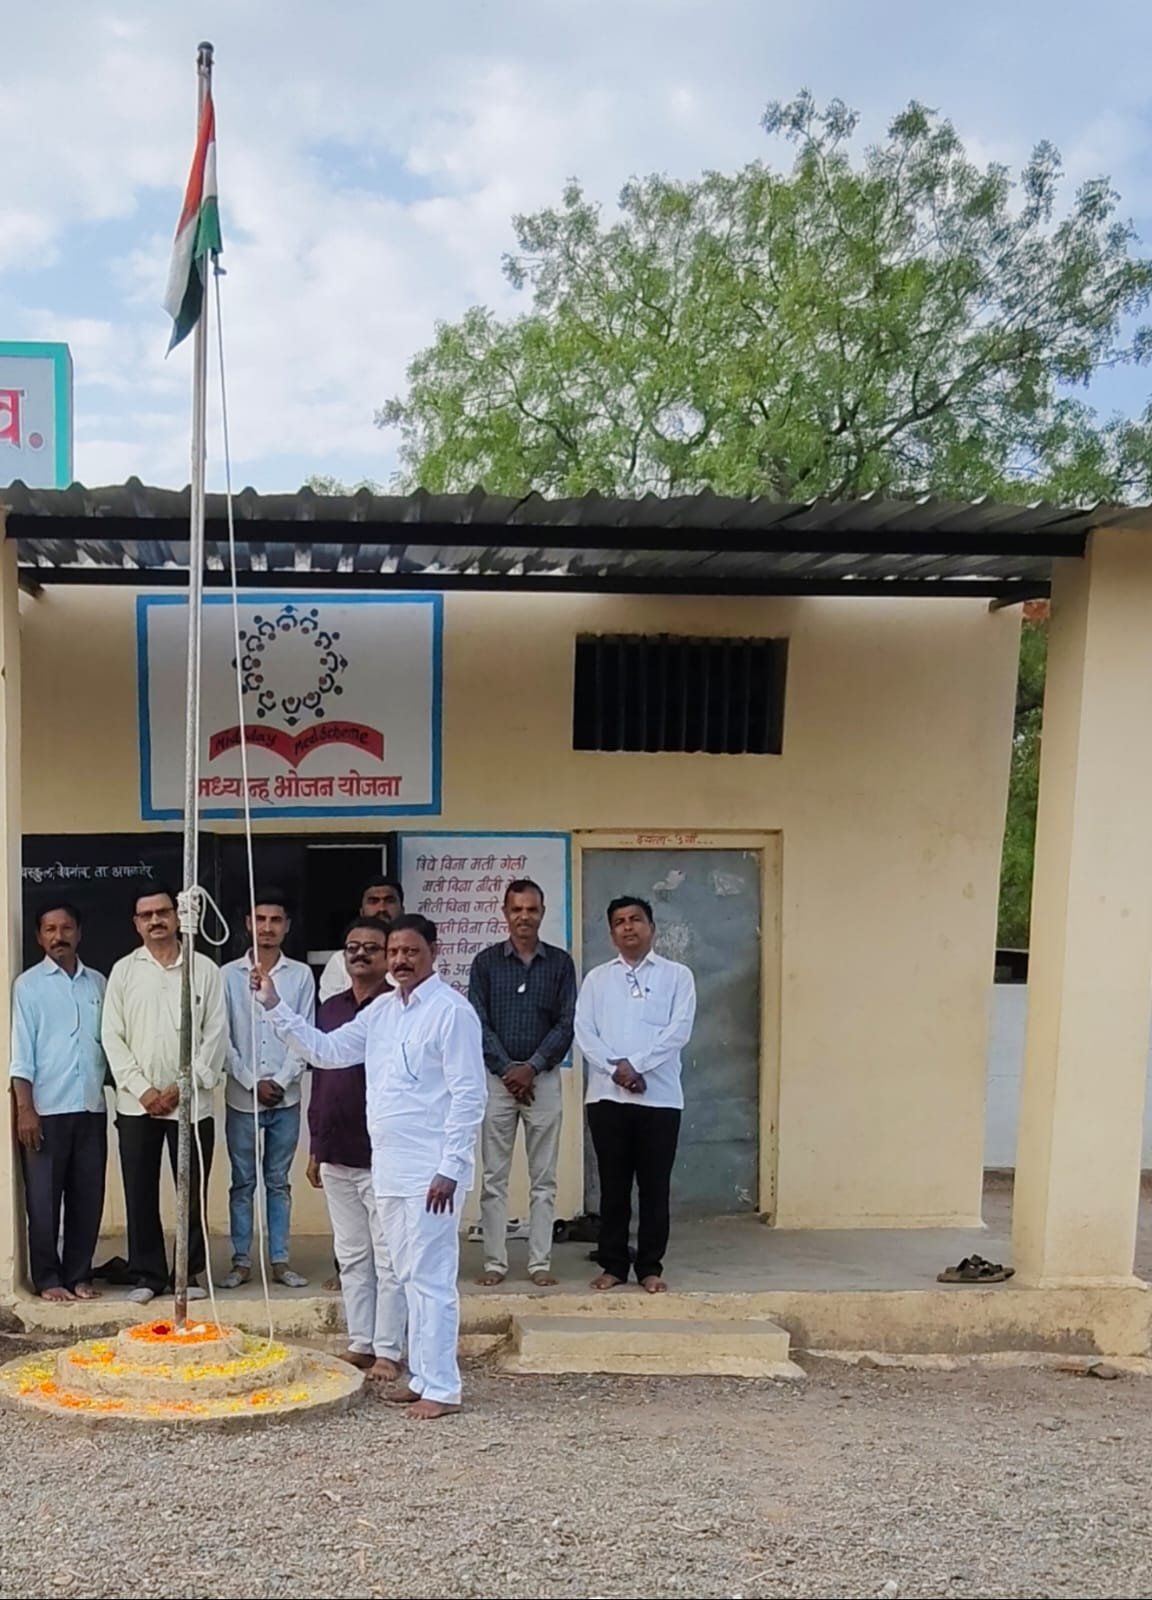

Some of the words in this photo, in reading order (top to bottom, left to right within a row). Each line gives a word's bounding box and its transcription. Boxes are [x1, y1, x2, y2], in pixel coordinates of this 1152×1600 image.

[274, 769, 334, 798] भोजन
[338, 769, 403, 798] योजना
[440, 854, 468, 871] विना
[470, 854, 497, 870] मती
[500, 854, 528, 870] गेली
[422, 876, 447, 892] मती
[448, 876, 473, 893] विना
[476, 875, 503, 892] नीती
[446, 897, 472, 913] विना
[457, 917, 484, 934] विना
